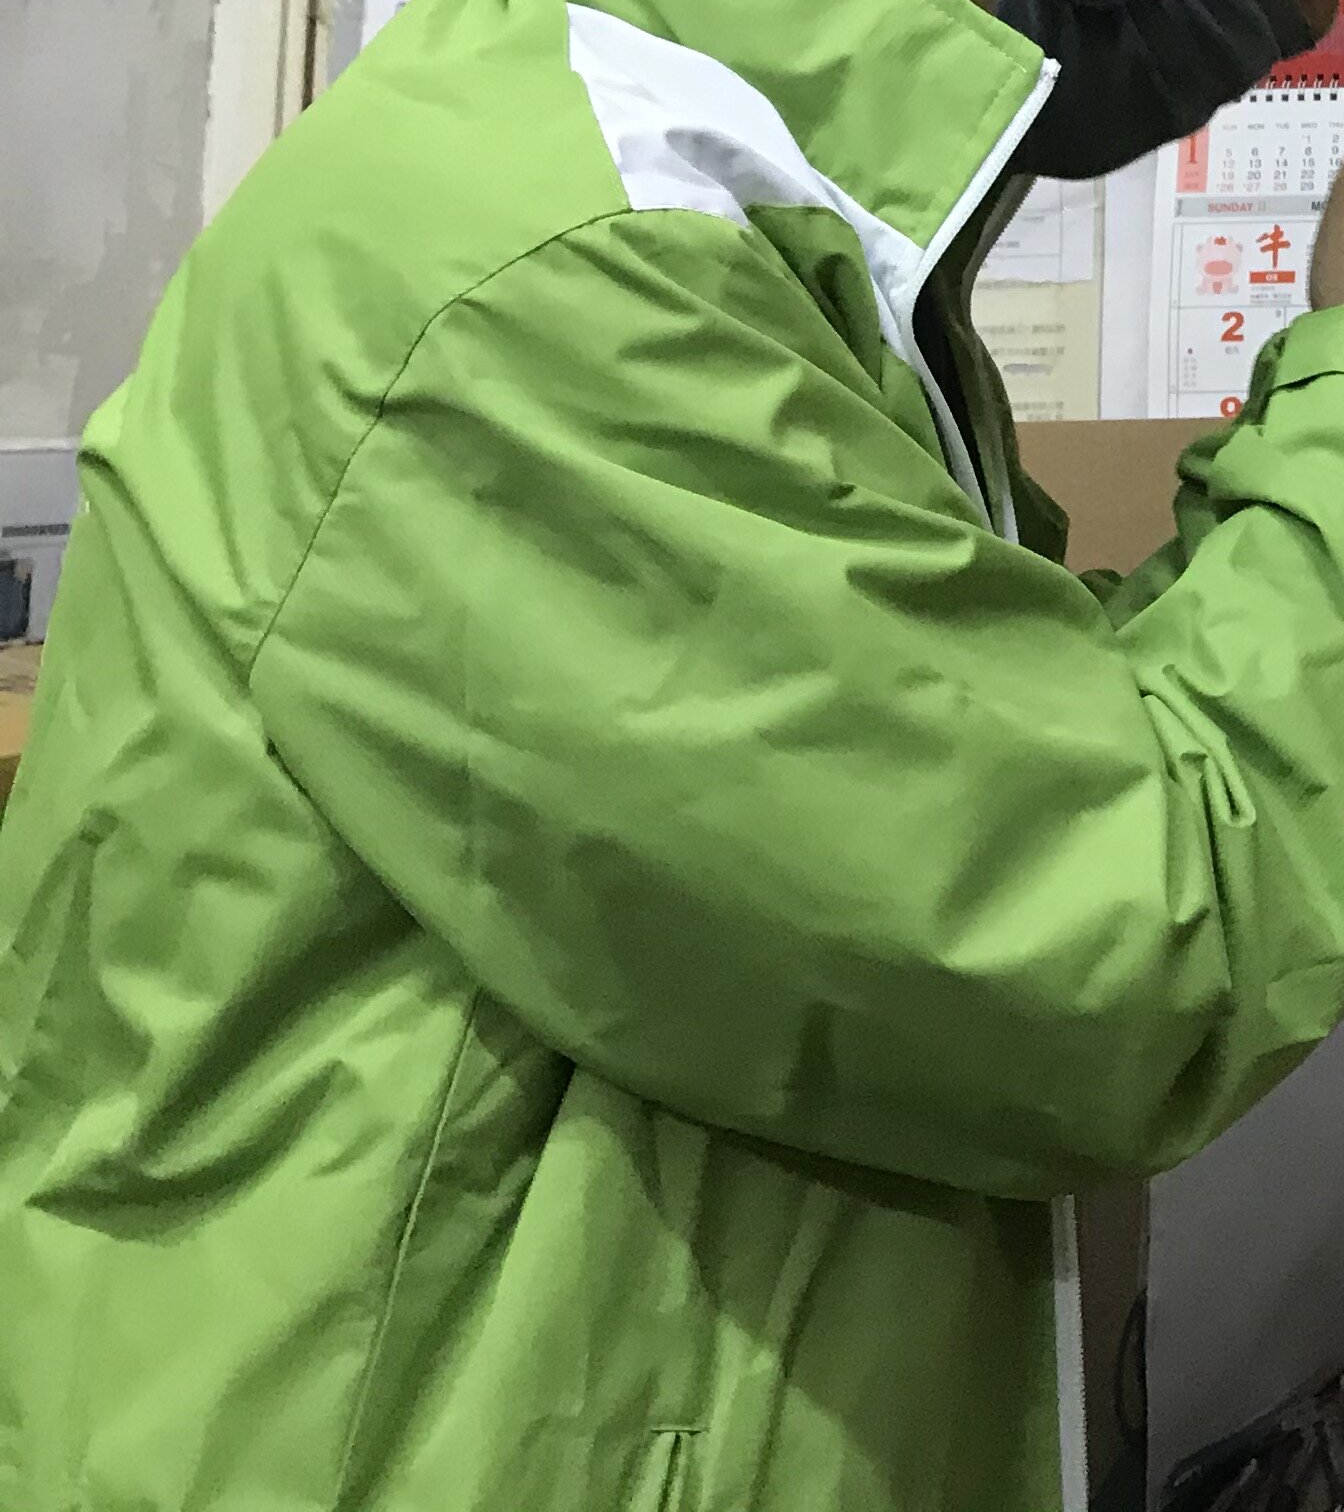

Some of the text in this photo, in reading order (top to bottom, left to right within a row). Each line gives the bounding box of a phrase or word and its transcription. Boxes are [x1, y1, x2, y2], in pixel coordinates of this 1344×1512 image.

[1207, 201, 1253, 213] SUNDAY
[1256, 225, 1290, 268] 牛
[1221, 312, 1244, 341] 2
